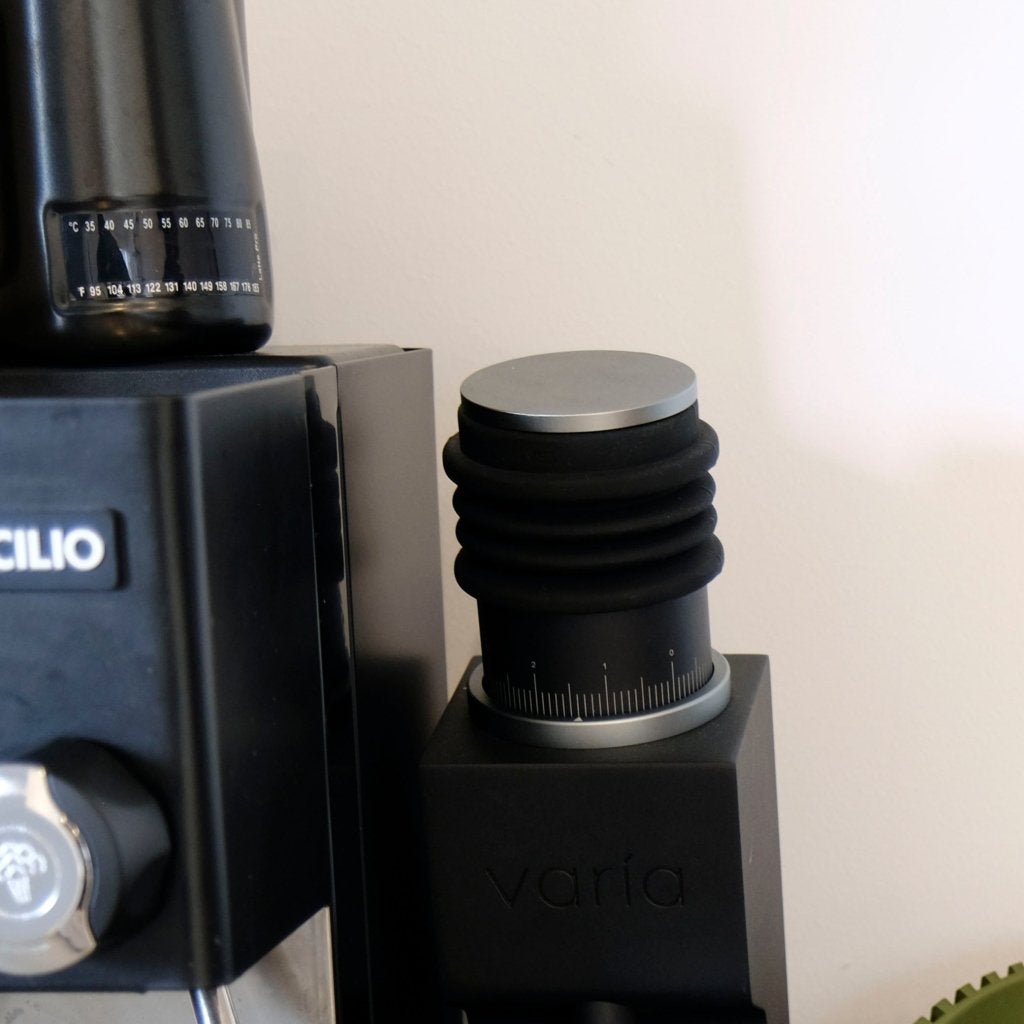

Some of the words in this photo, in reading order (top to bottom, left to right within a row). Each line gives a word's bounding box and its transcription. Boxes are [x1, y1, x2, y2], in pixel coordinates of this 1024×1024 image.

[84, 220, 96, 232] 35
[104, 219, 115, 231] 40
[123, 218, 134, 230] 45
[142, 218, 153, 229] 50
[161, 217, 172, 229] 55
[178, 217, 189, 229] 60
[195, 217, 205, 229] 65
[211, 217, 220, 229] 70
[224, 217, 233, 229] 75
[89, 285, 102, 297] 95
[107, 283, 123, 295] 104
[127, 283, 142, 294] 113
[145, 282, 161, 294] 122
[164, 281, 179, 292] 131
[183, 281, 197, 292] 140
[199, 281, 213, 292] 149
[215, 281, 228, 292] 158
[530, 660, 537, 669] 2
[668, 648, 675, 657] 0
